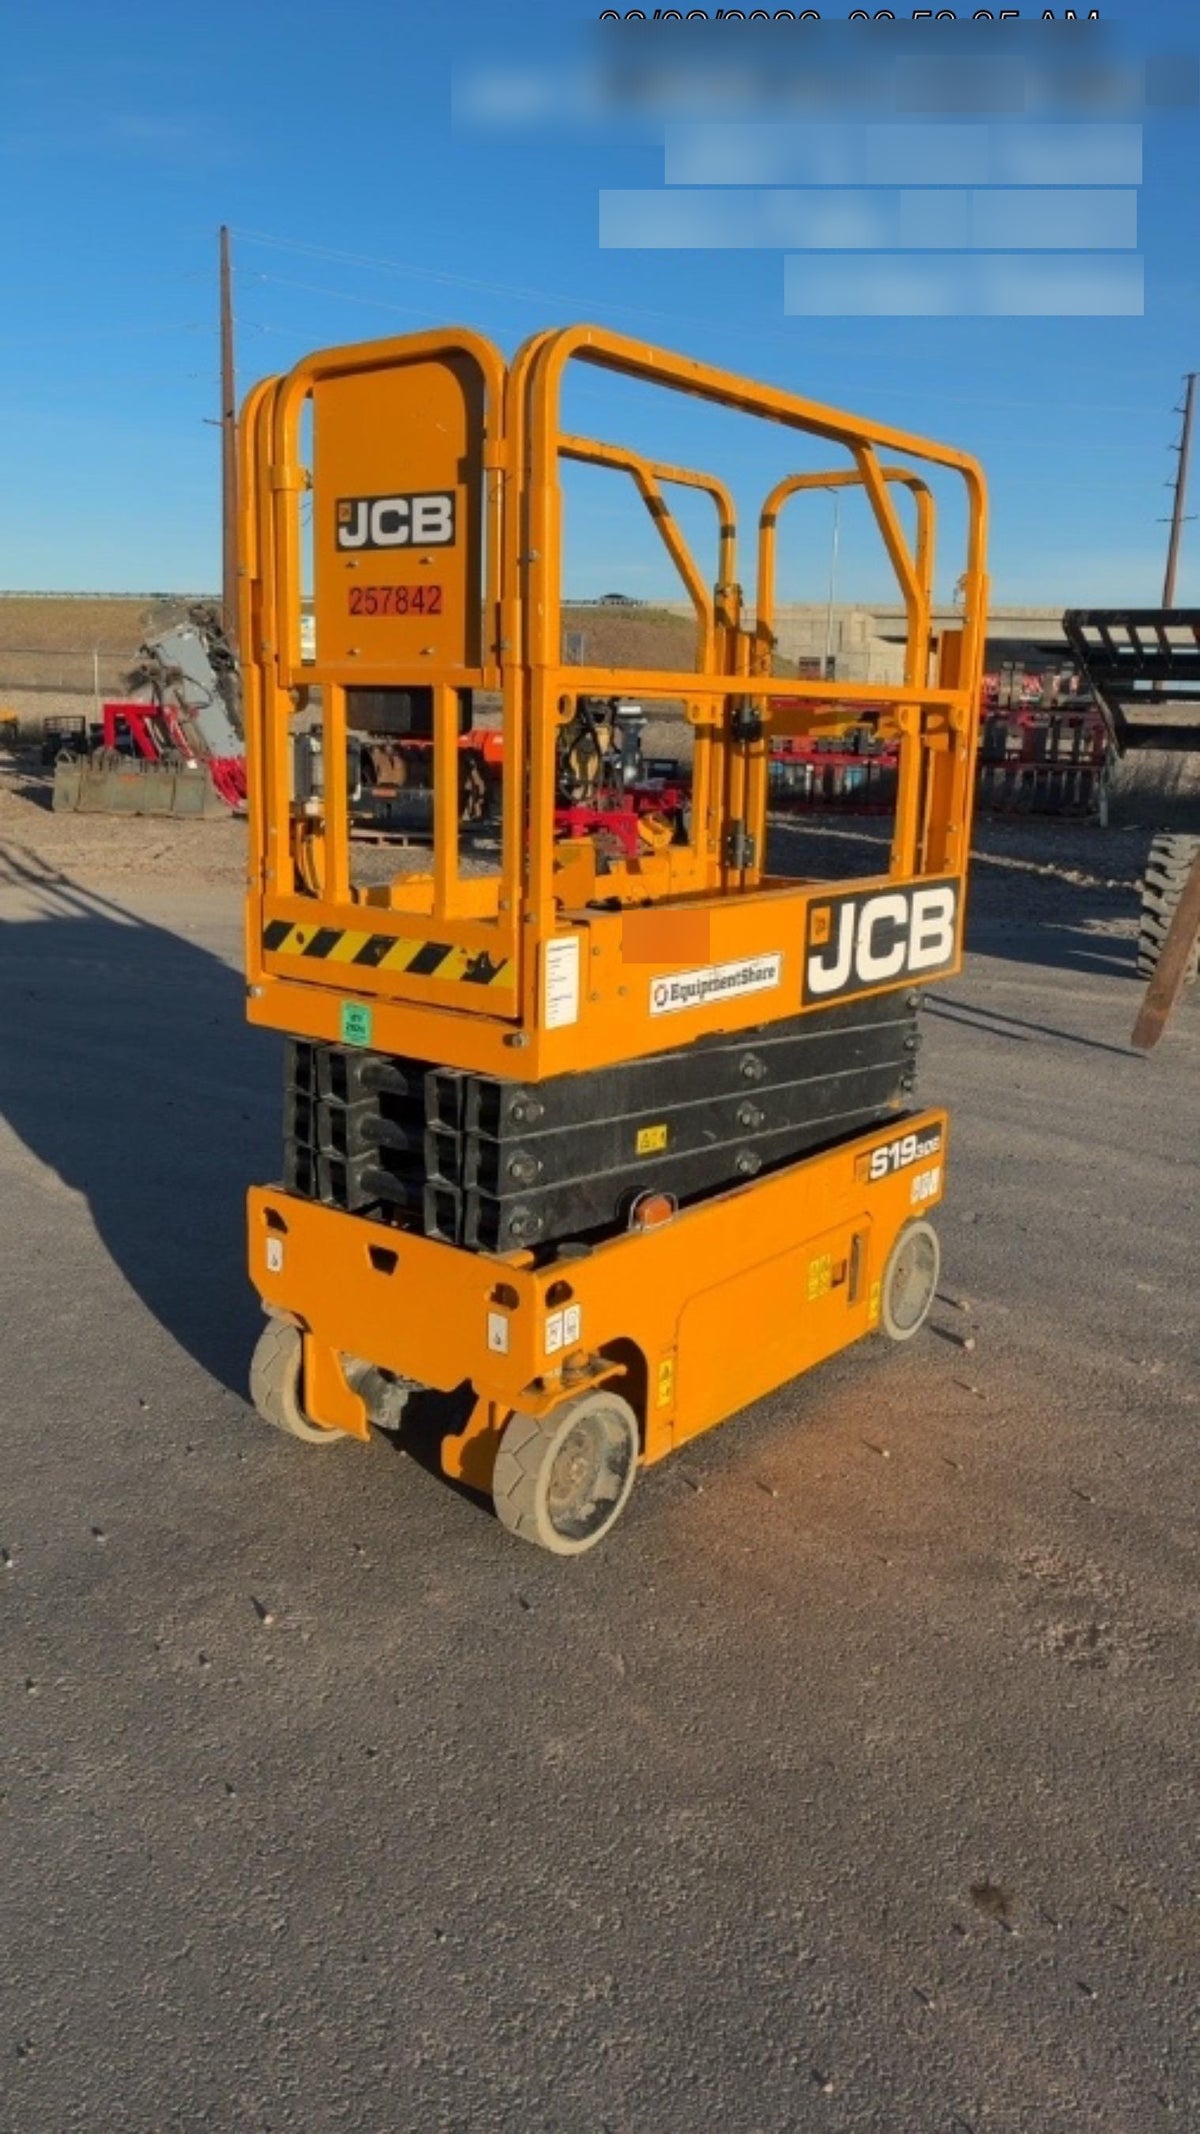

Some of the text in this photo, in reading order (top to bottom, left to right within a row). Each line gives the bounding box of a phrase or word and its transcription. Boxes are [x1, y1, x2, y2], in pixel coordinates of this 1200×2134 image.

[338, 496, 453, 547] JCB
[350, 585, 442, 615] 257842
[808, 887, 955, 994] JCB
[670, 966, 776, 1002] EquipmentShare
